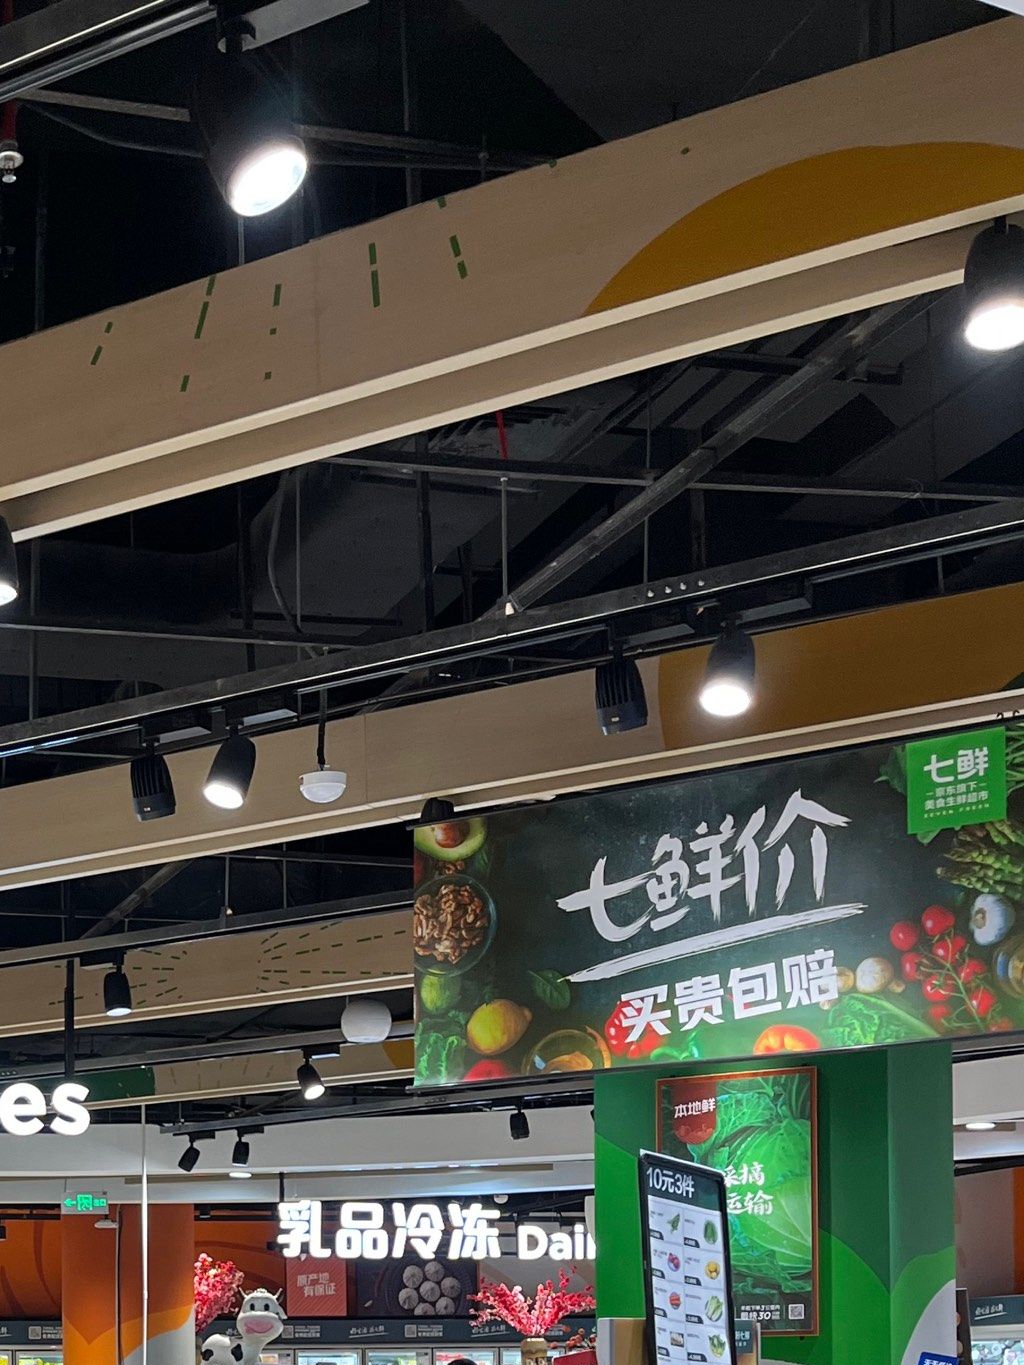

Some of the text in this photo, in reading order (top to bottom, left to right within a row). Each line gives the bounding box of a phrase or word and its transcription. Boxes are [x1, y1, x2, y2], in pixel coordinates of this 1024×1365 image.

[923, 746, 989, 783] 七鲜
[557, 788, 853, 942] 七鲜价
[620, 949, 840, 1043] 买贵包赔
[674, 1097, 716, 1119] 本地鲜
[646, 1166, 696, 1199] 10元3件
[276, 1199, 502, 1260] 乳品冷冻
[297, 1272, 330, 1287] 原产地
[303, 1282, 336, 1298] 有保证
